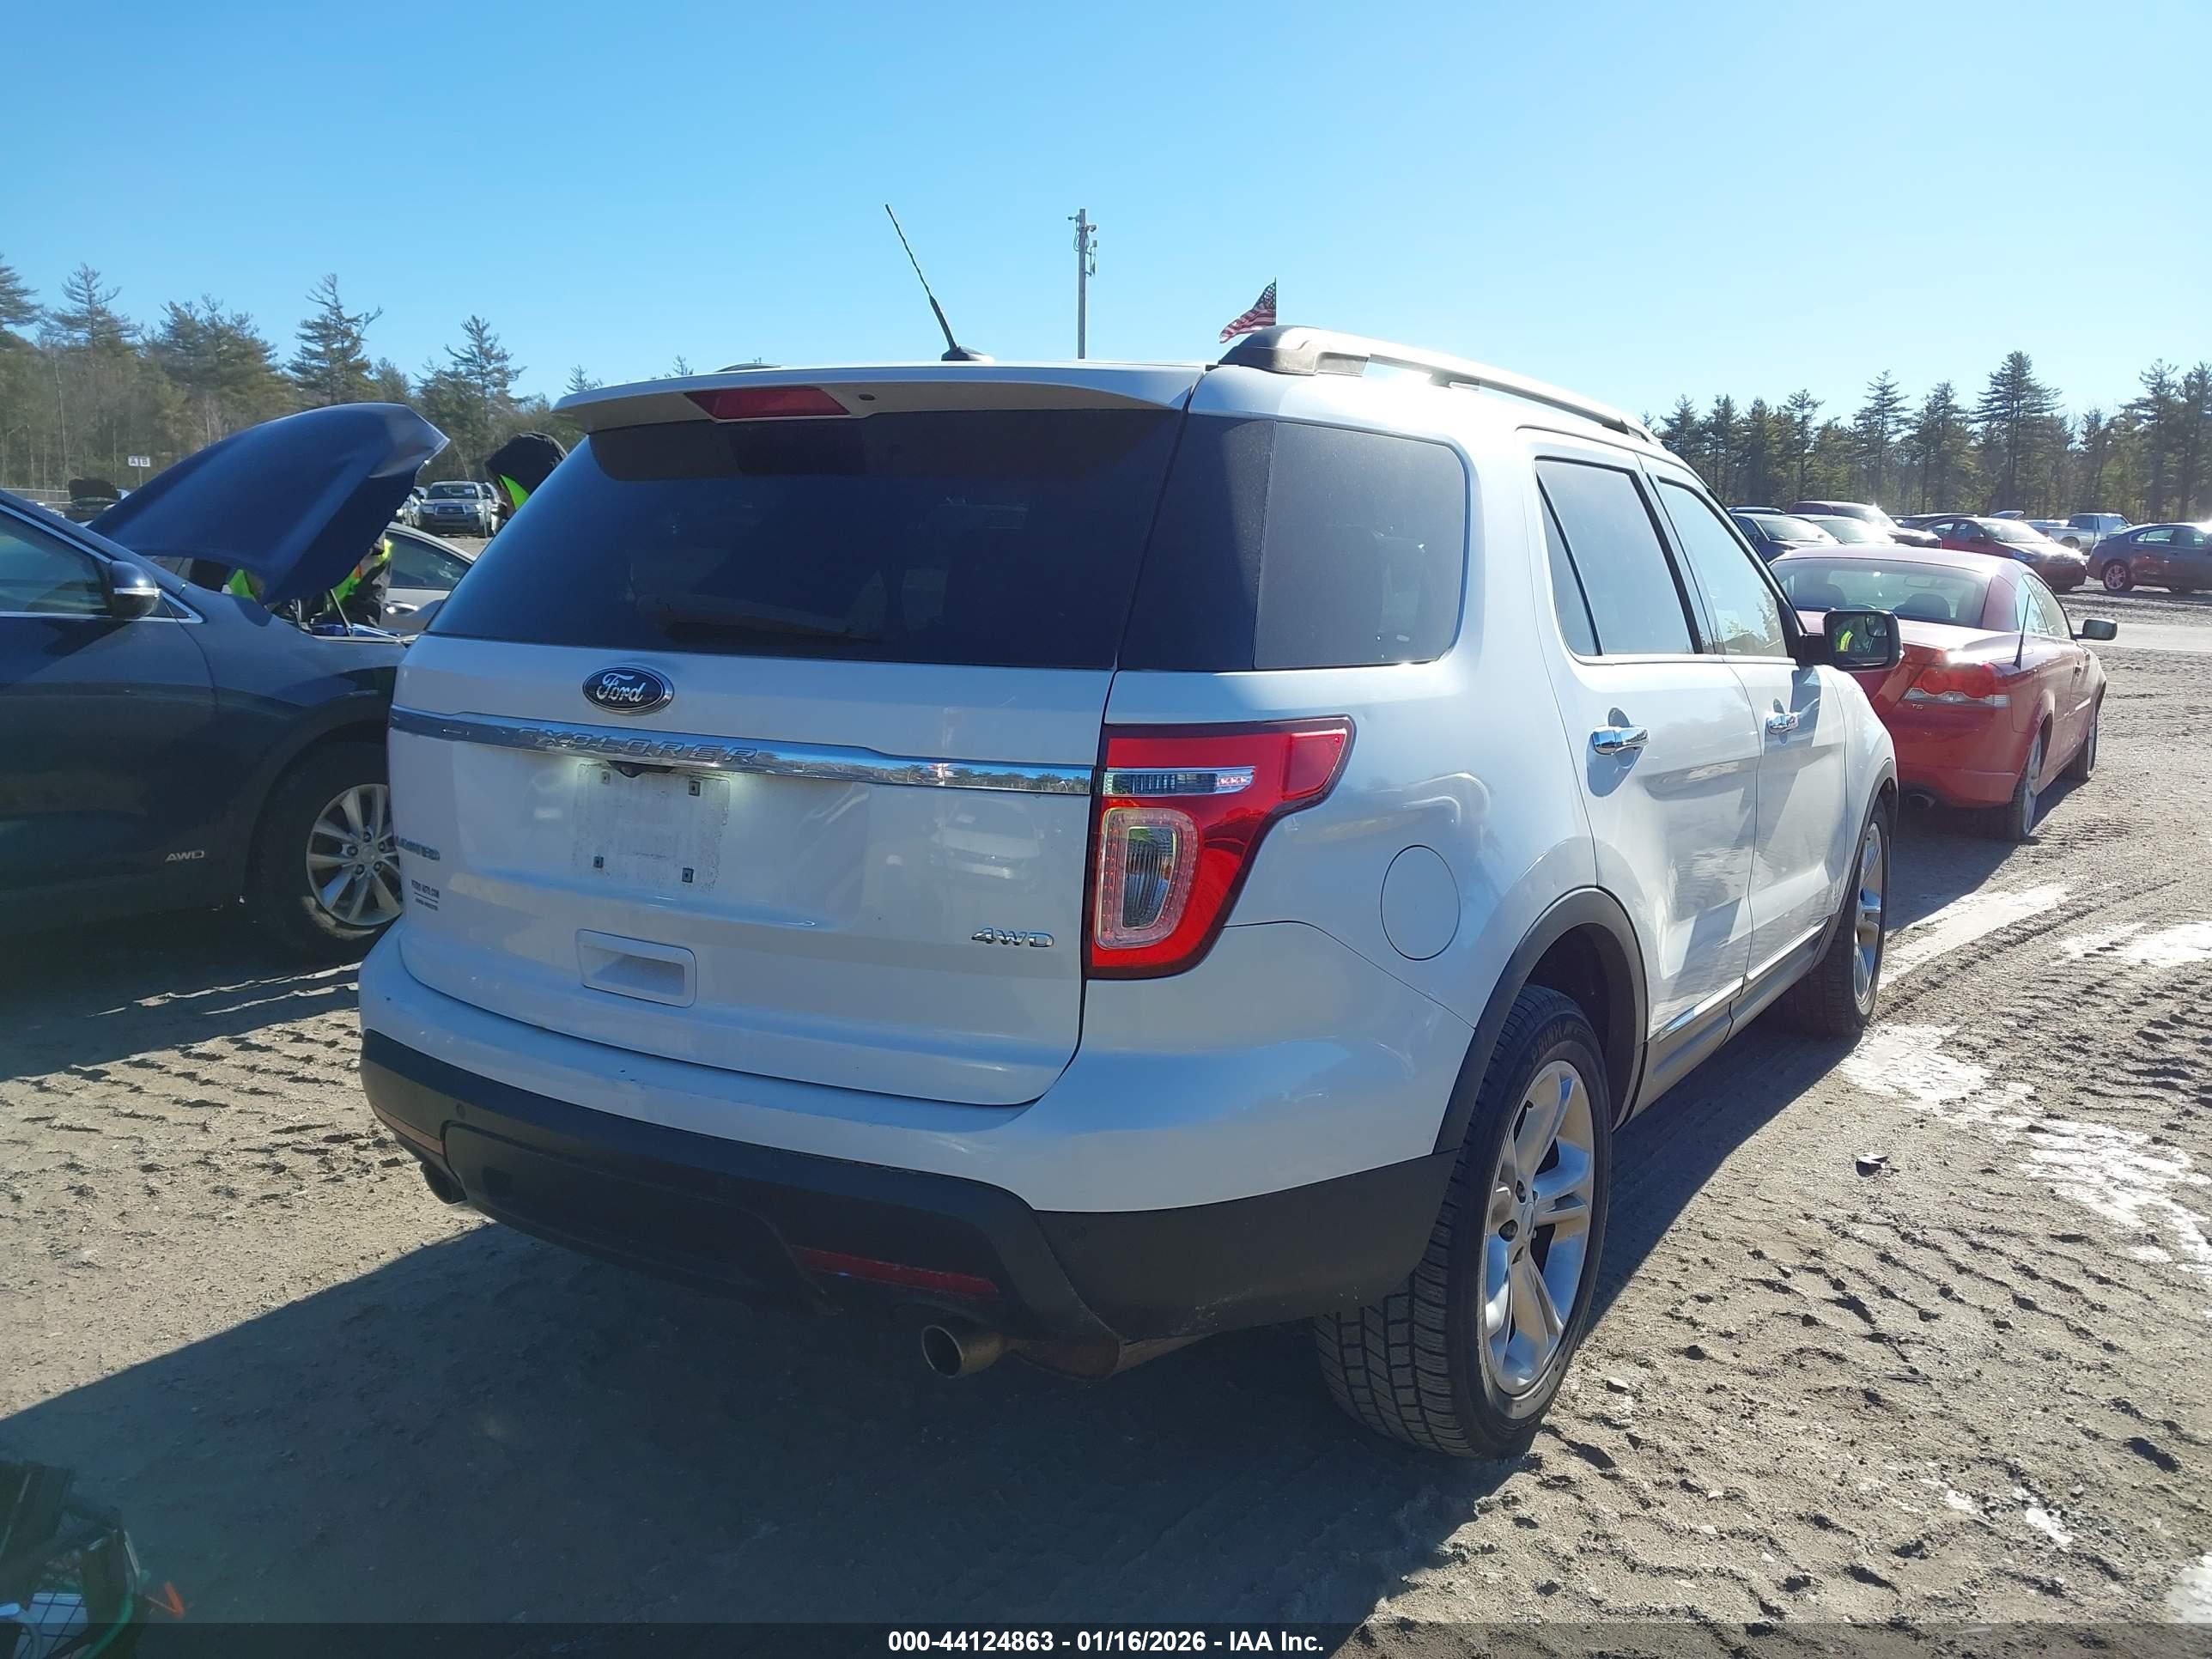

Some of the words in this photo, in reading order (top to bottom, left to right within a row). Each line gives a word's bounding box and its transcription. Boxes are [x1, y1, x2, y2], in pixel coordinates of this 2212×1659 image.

[596, 672, 647, 702] Ford
[517, 726, 761, 764] EXPLORER
[164, 850, 205, 863] AWD
[970, 927, 1054, 947] 4WD
